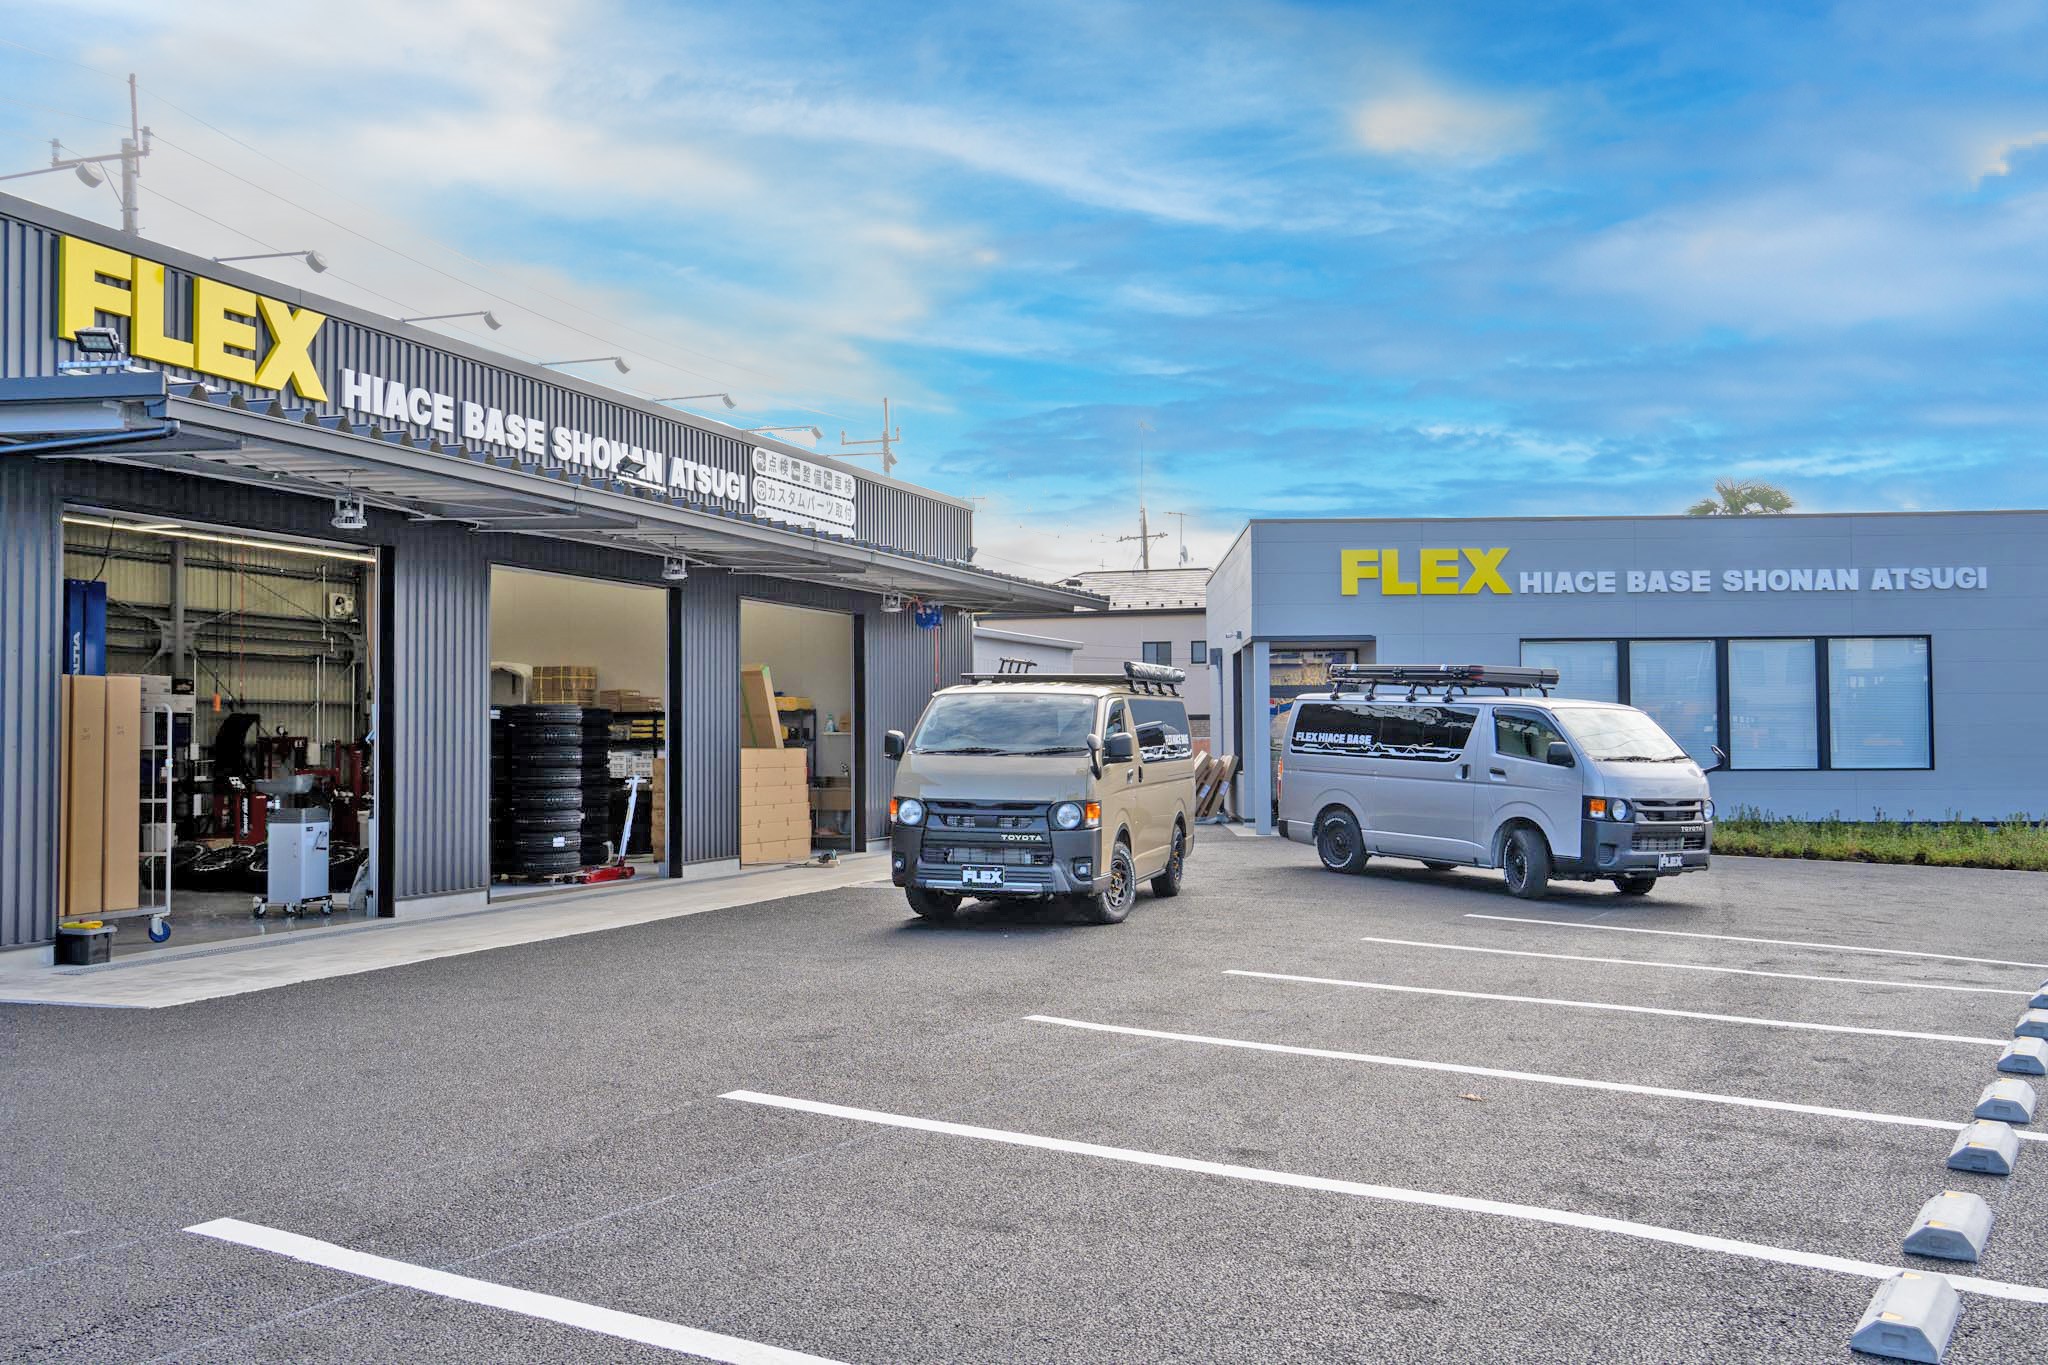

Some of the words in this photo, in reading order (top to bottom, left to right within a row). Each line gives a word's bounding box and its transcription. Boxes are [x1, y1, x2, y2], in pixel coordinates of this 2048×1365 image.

[58, 234, 329, 403] FLEX
[342, 368, 454, 433] HIACE
[462, 400, 546, 456] BASE
[668, 456, 747, 504] ATSUGI
[768, 455, 789, 478] 点検
[1341, 548, 1513, 596] FLEX
[1519, 571, 1616, 594] HIACE
[1627, 569, 1711, 593] BASE
[1722, 568, 1859, 592] SHONAN
[1871, 566, 1987, 590] ATSUGI
[1295, 731, 1319, 743] FLEX
[1318, 732, 1346, 745] HIACE
[1346, 733, 1372, 745] BASE
[962, 870, 1003, 884] FLEX
